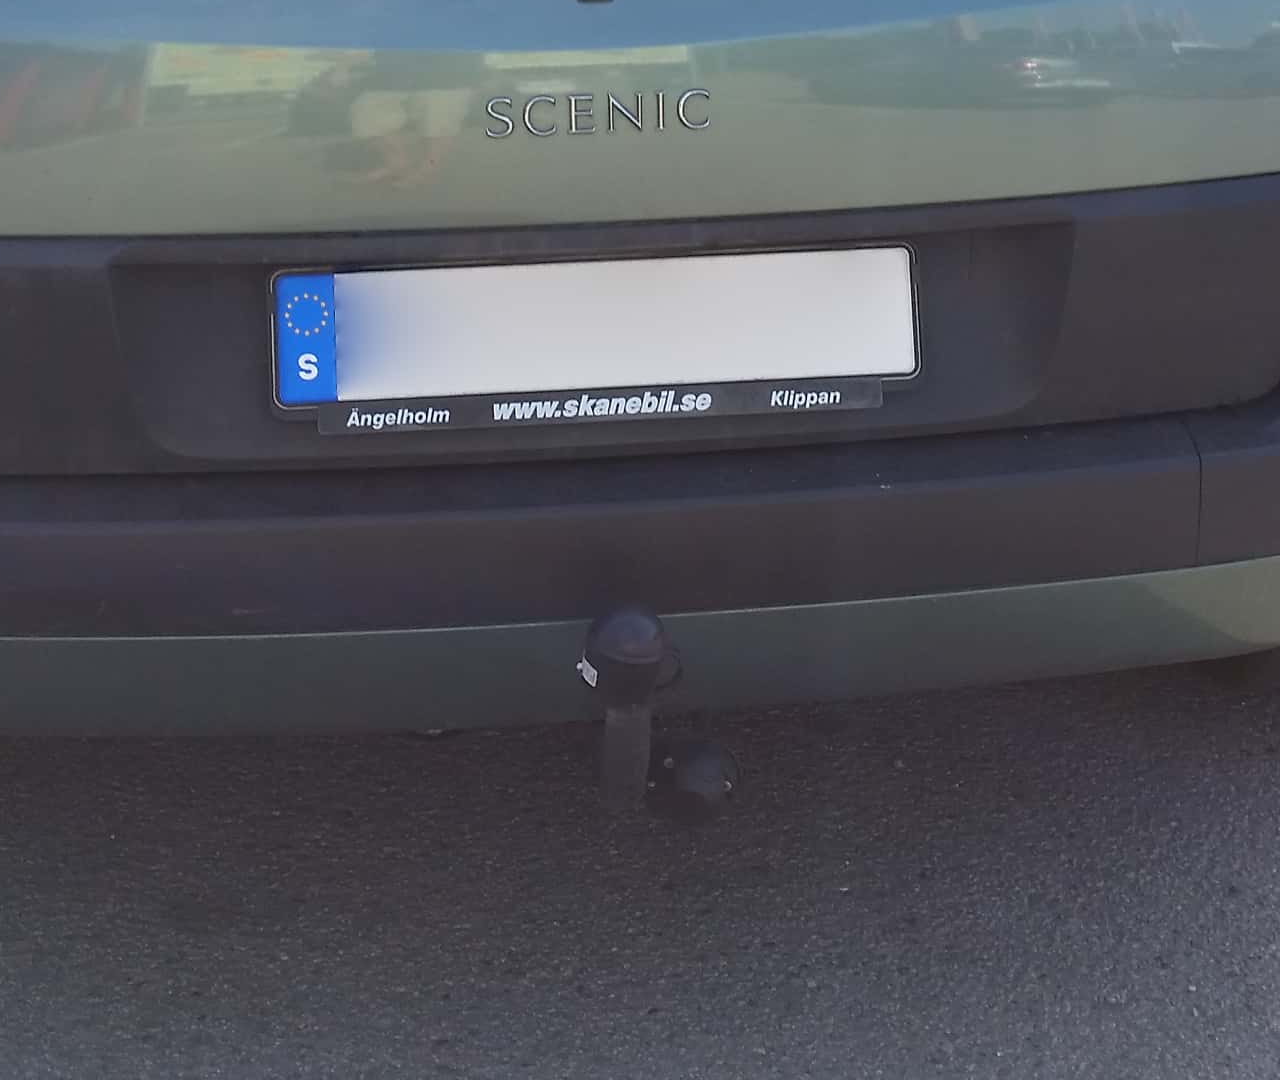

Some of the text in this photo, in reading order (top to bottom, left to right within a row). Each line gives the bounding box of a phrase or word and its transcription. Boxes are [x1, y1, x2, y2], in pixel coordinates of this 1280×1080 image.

[484, 87, 712, 139] SCENIC
[297, 352, 320, 381] S
[345, 386, 843, 429] Ängelholm www.skanebil.se Klippan
